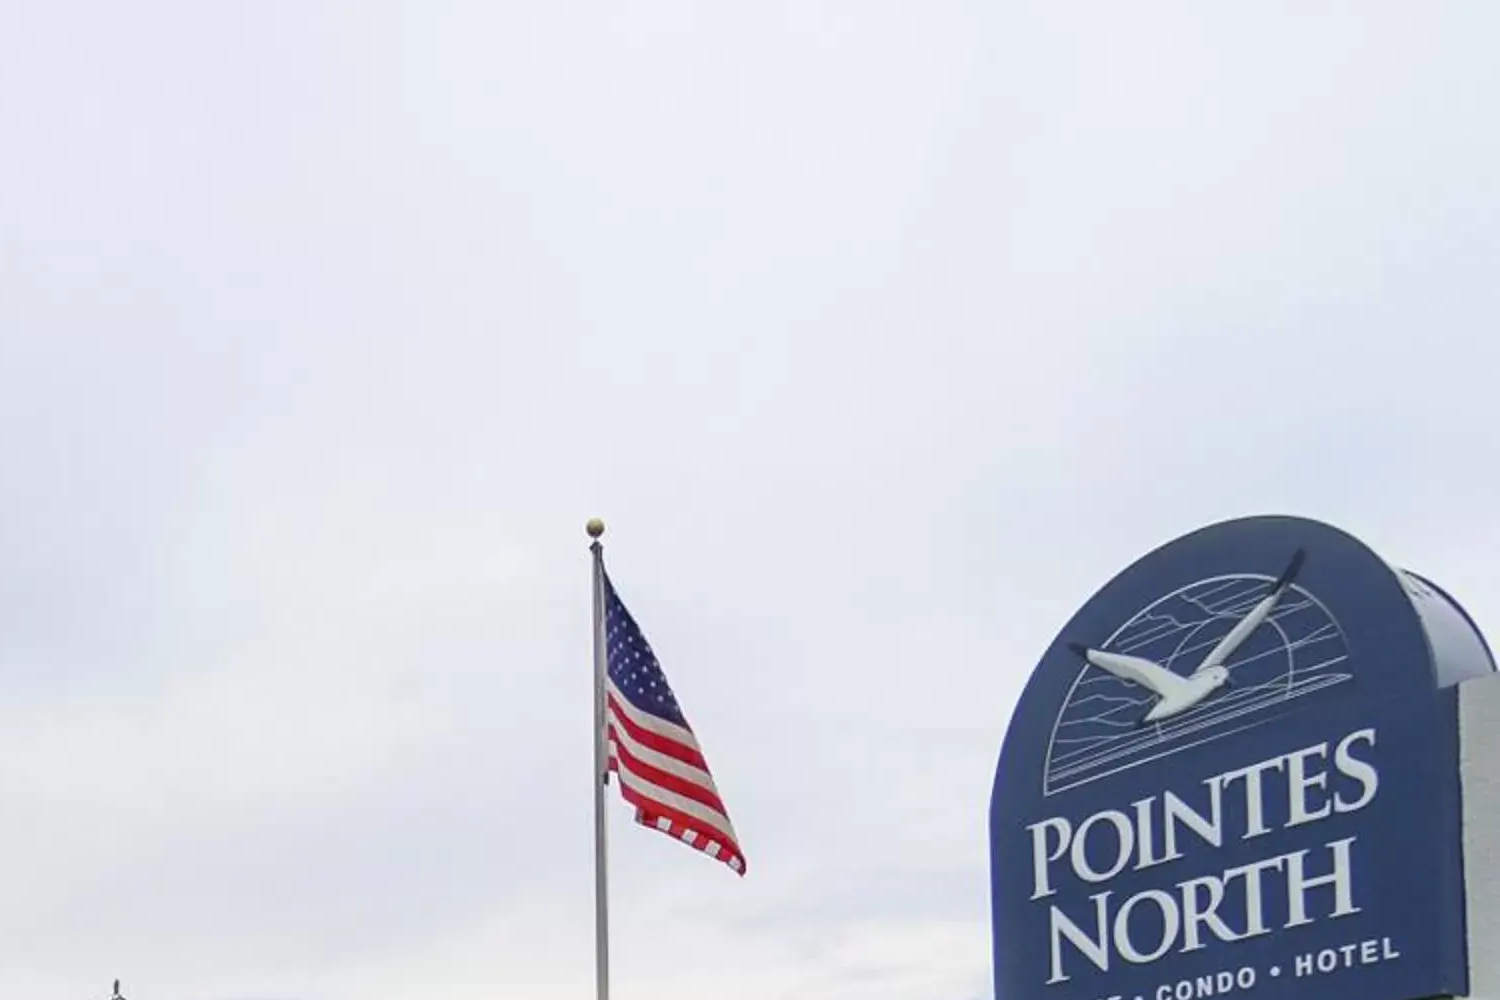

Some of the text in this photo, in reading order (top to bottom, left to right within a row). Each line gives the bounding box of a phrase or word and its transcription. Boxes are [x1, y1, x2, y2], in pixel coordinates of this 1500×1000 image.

[1026, 727, 1380, 900] POINTES
[1045, 836, 1362, 986] NORTH
[1295, 937, 1400, 977] HOTEL
